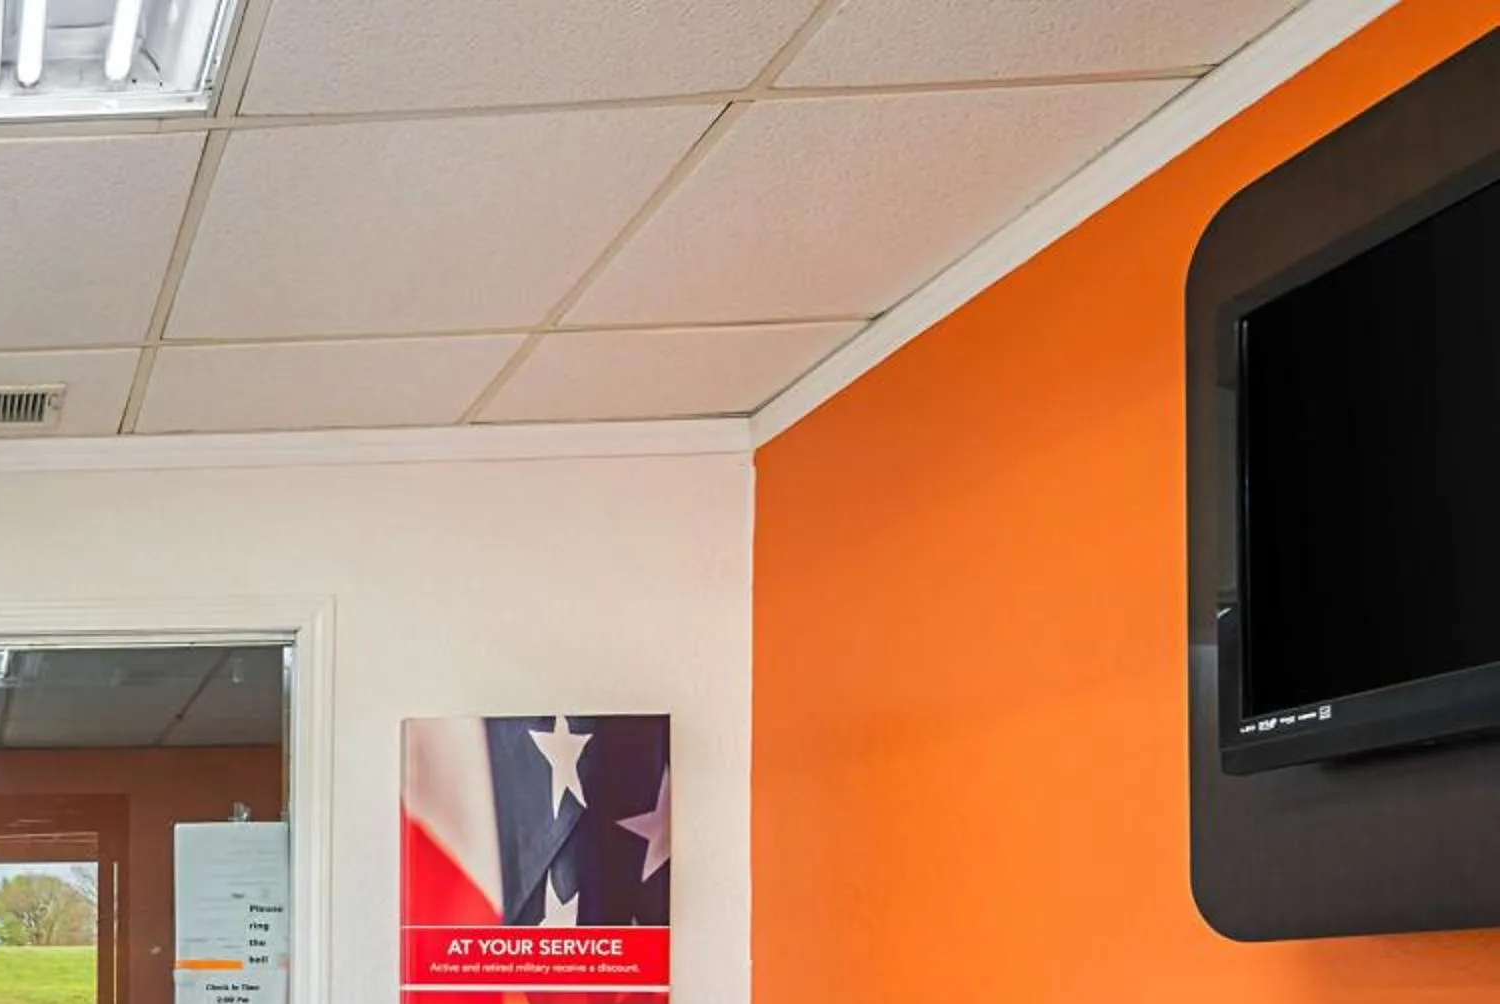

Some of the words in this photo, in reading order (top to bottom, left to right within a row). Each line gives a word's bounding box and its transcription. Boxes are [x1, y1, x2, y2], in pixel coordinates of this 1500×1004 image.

[249, 904, 284, 914] Please
[249, 922, 270, 932] ring
[249, 938, 266, 947] the
[448, 939, 474, 956] AT
[478, 939, 533, 956] YOUR
[539, 939, 623, 956] SERVICE
[249, 955, 268, 964] bell
[430, 962, 459, 973] Active
[462, 962, 480, 973] and
[482, 962, 514, 973] retired
[516, 962, 550, 974] military
[552, 963, 587, 973] receive
